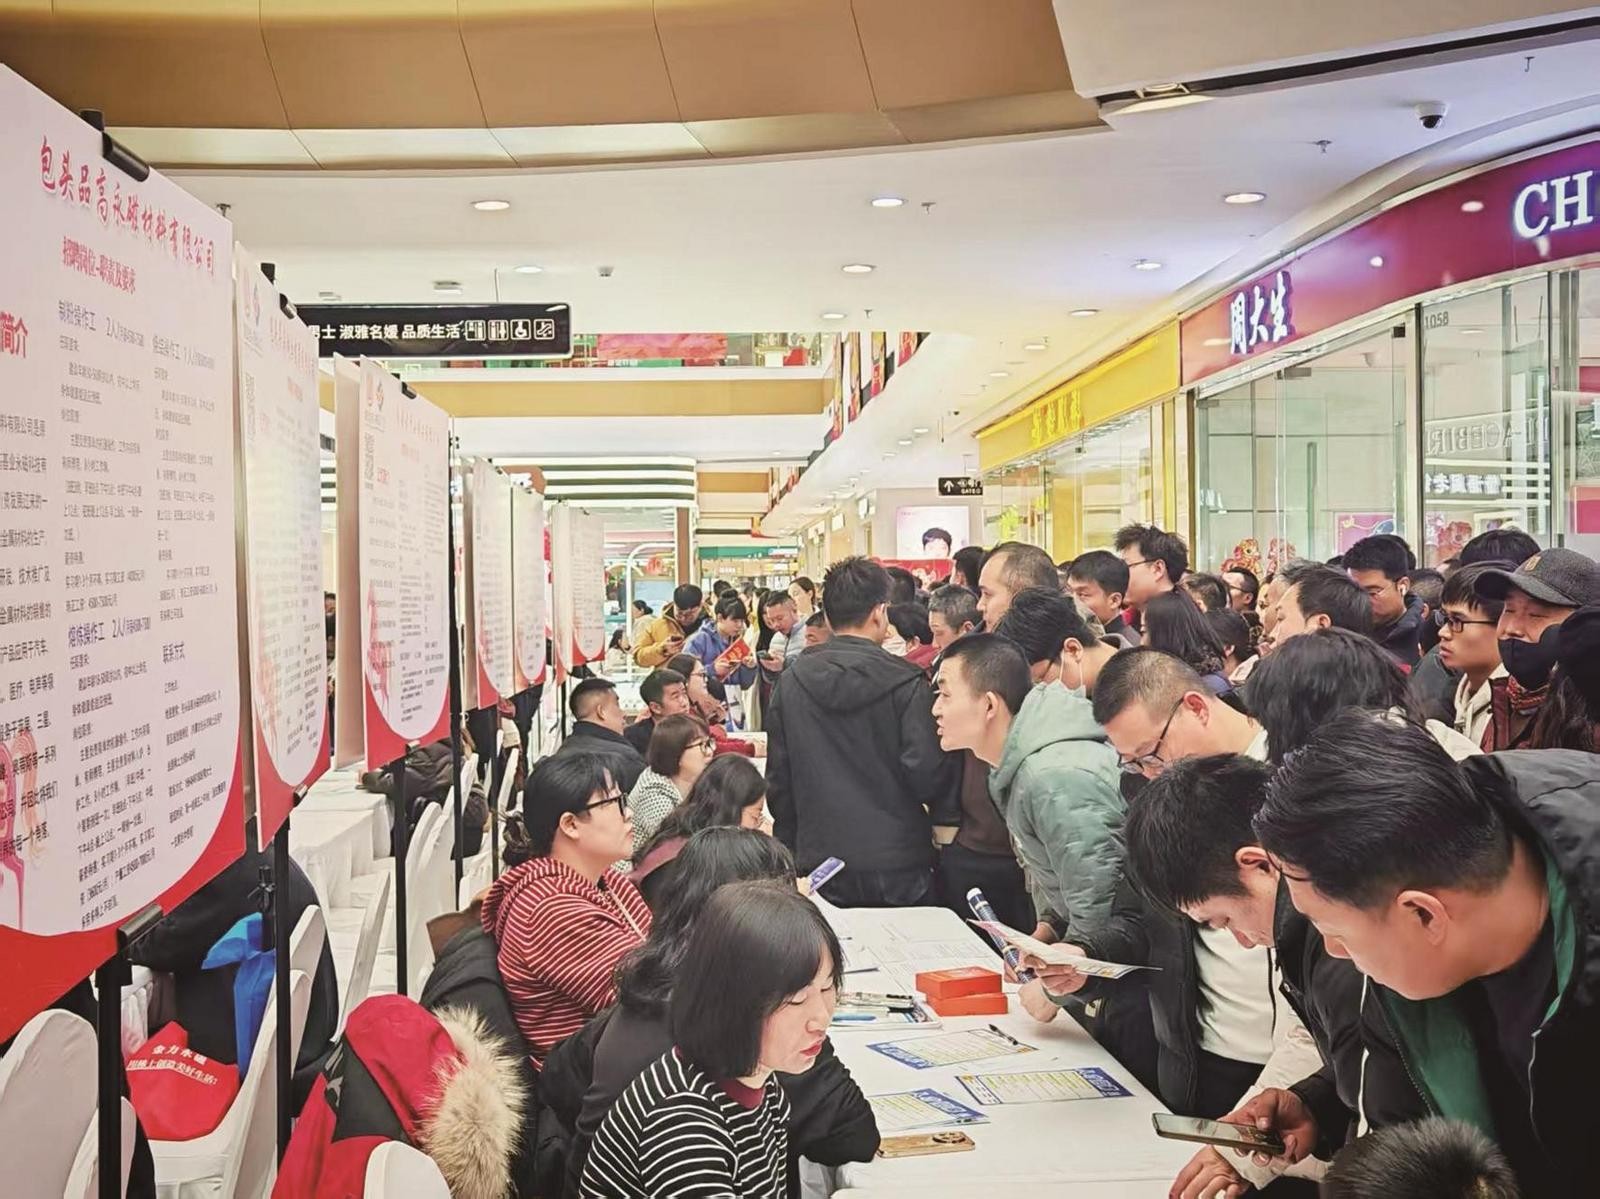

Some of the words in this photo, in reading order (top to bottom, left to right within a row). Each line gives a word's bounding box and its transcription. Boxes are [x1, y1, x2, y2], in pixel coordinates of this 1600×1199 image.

[39, 135, 215, 276] 包头品高永磁材料有限公司
[1514, 170, 1594, 239] CH
[0, 312, 28, 358] 简介
[339, 324, 399, 340] 淑雅名媛
[401, 324, 461, 340] 品质生活
[1230, 271, 1290, 354] 周大生
[1425, 311, 1449, 330] 1058
[152, 1045, 208, 1065] 金力永磁
